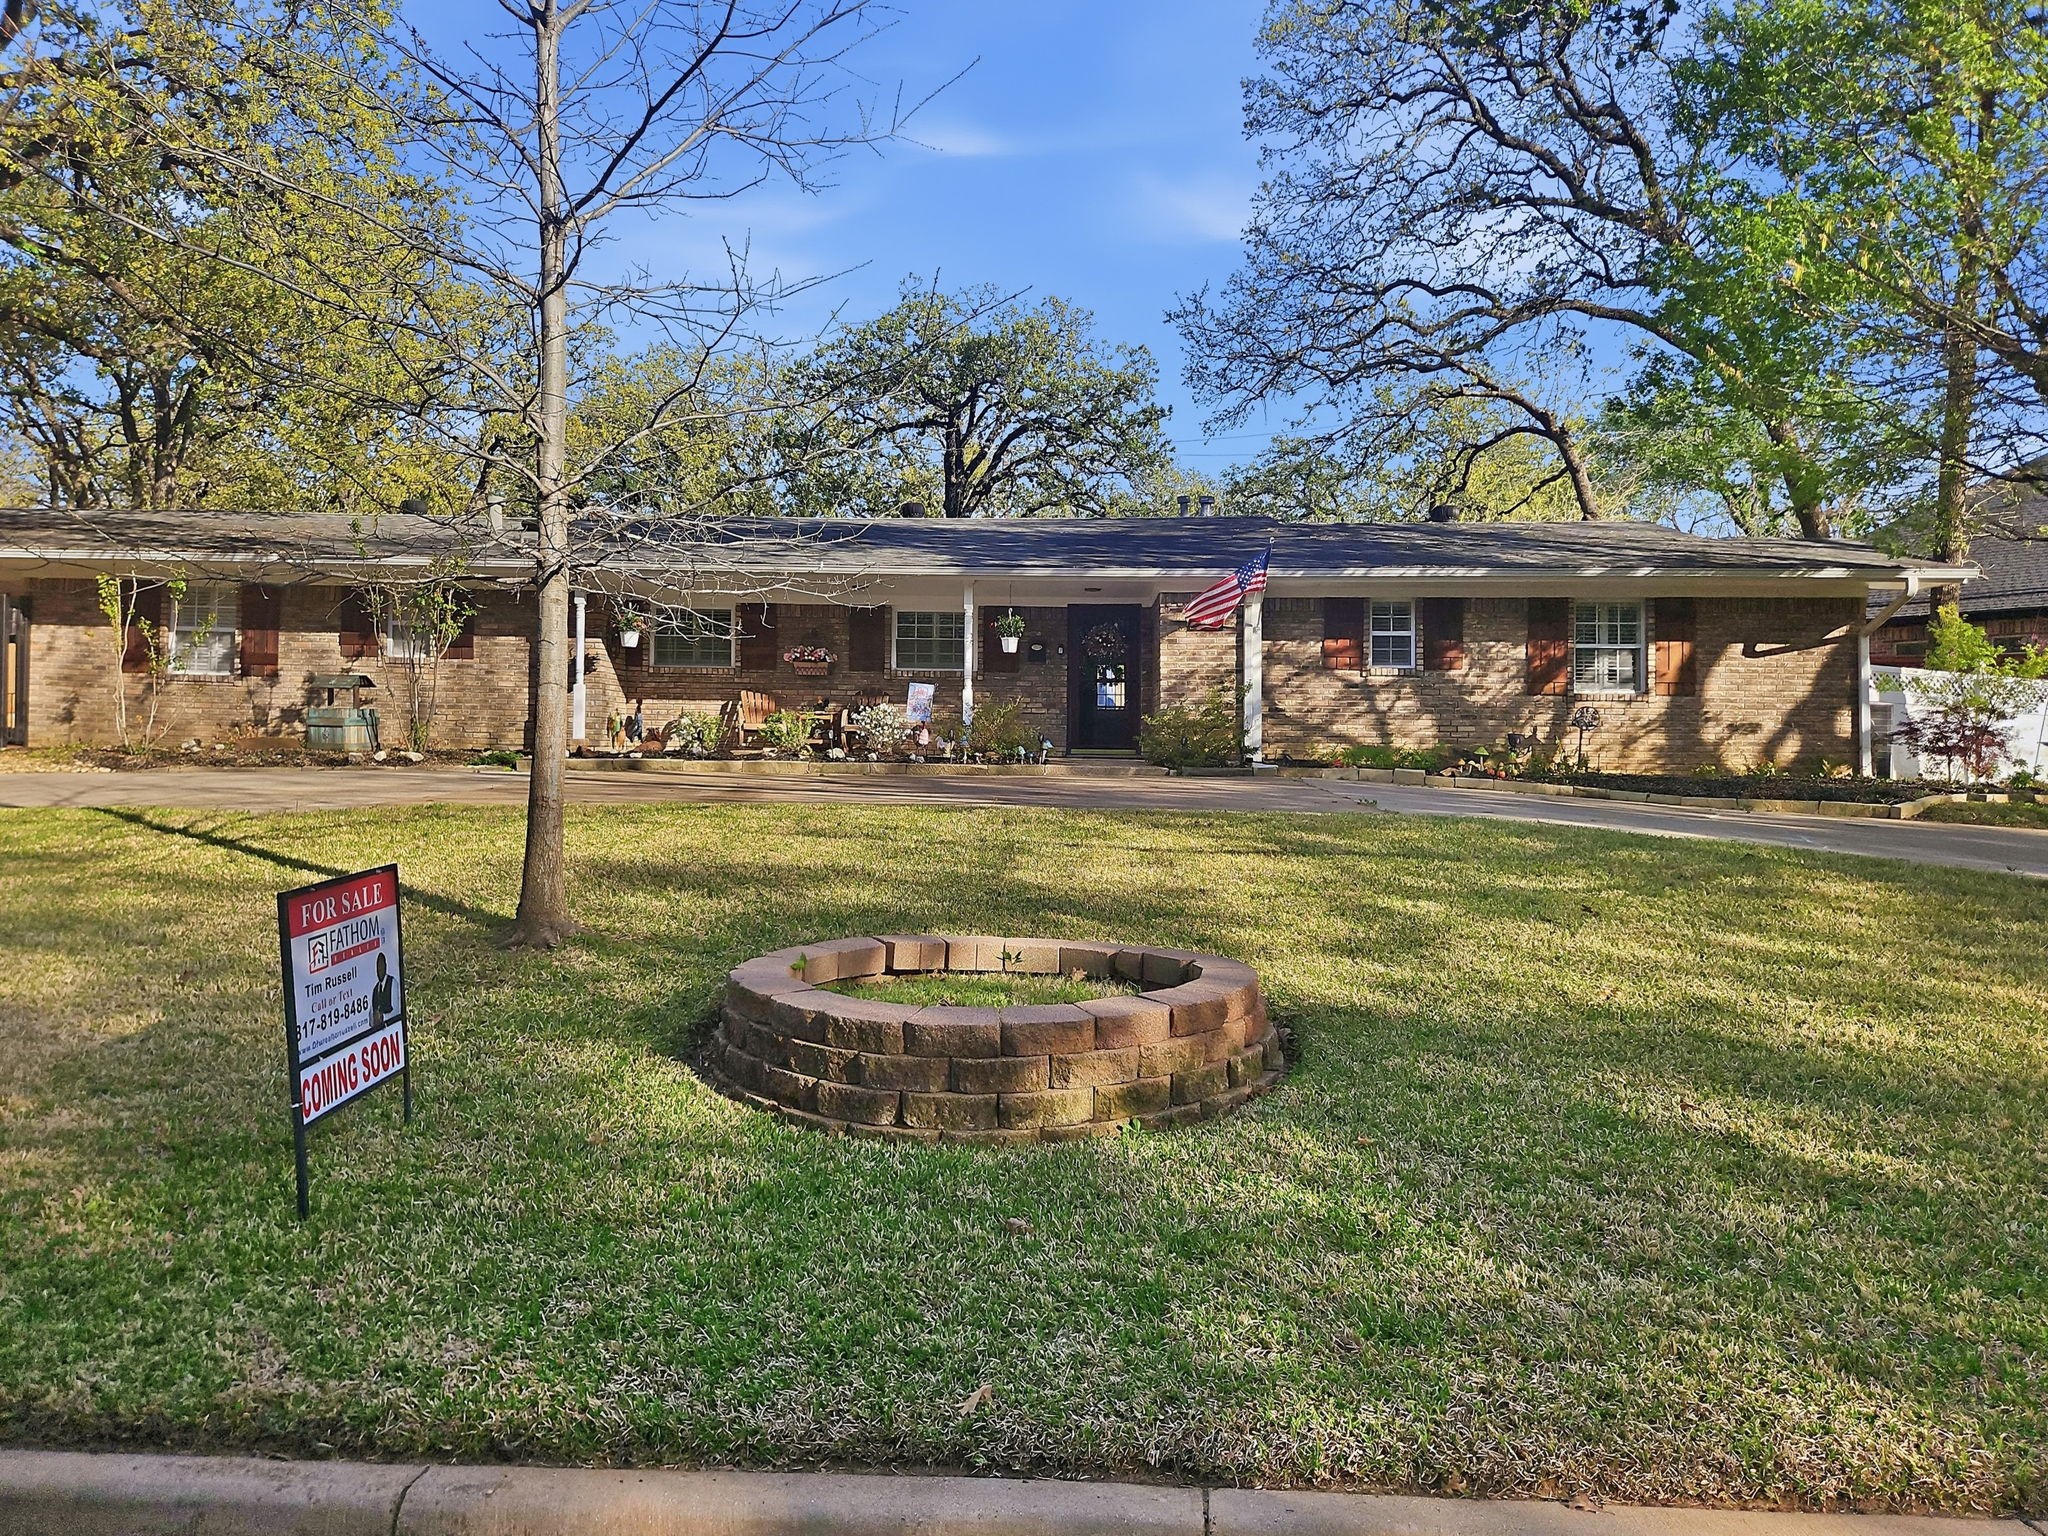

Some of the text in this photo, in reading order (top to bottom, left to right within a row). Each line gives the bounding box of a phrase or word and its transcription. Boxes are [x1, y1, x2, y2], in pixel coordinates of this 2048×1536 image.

[302, 882, 383, 928] FOR SALE
[330, 915, 380, 952] FATHOM
[305, 966, 358, 998] Tim Russell
[312, 987, 353, 1013] Call or Text
[302, 1031, 401, 1119] COMING SOON
